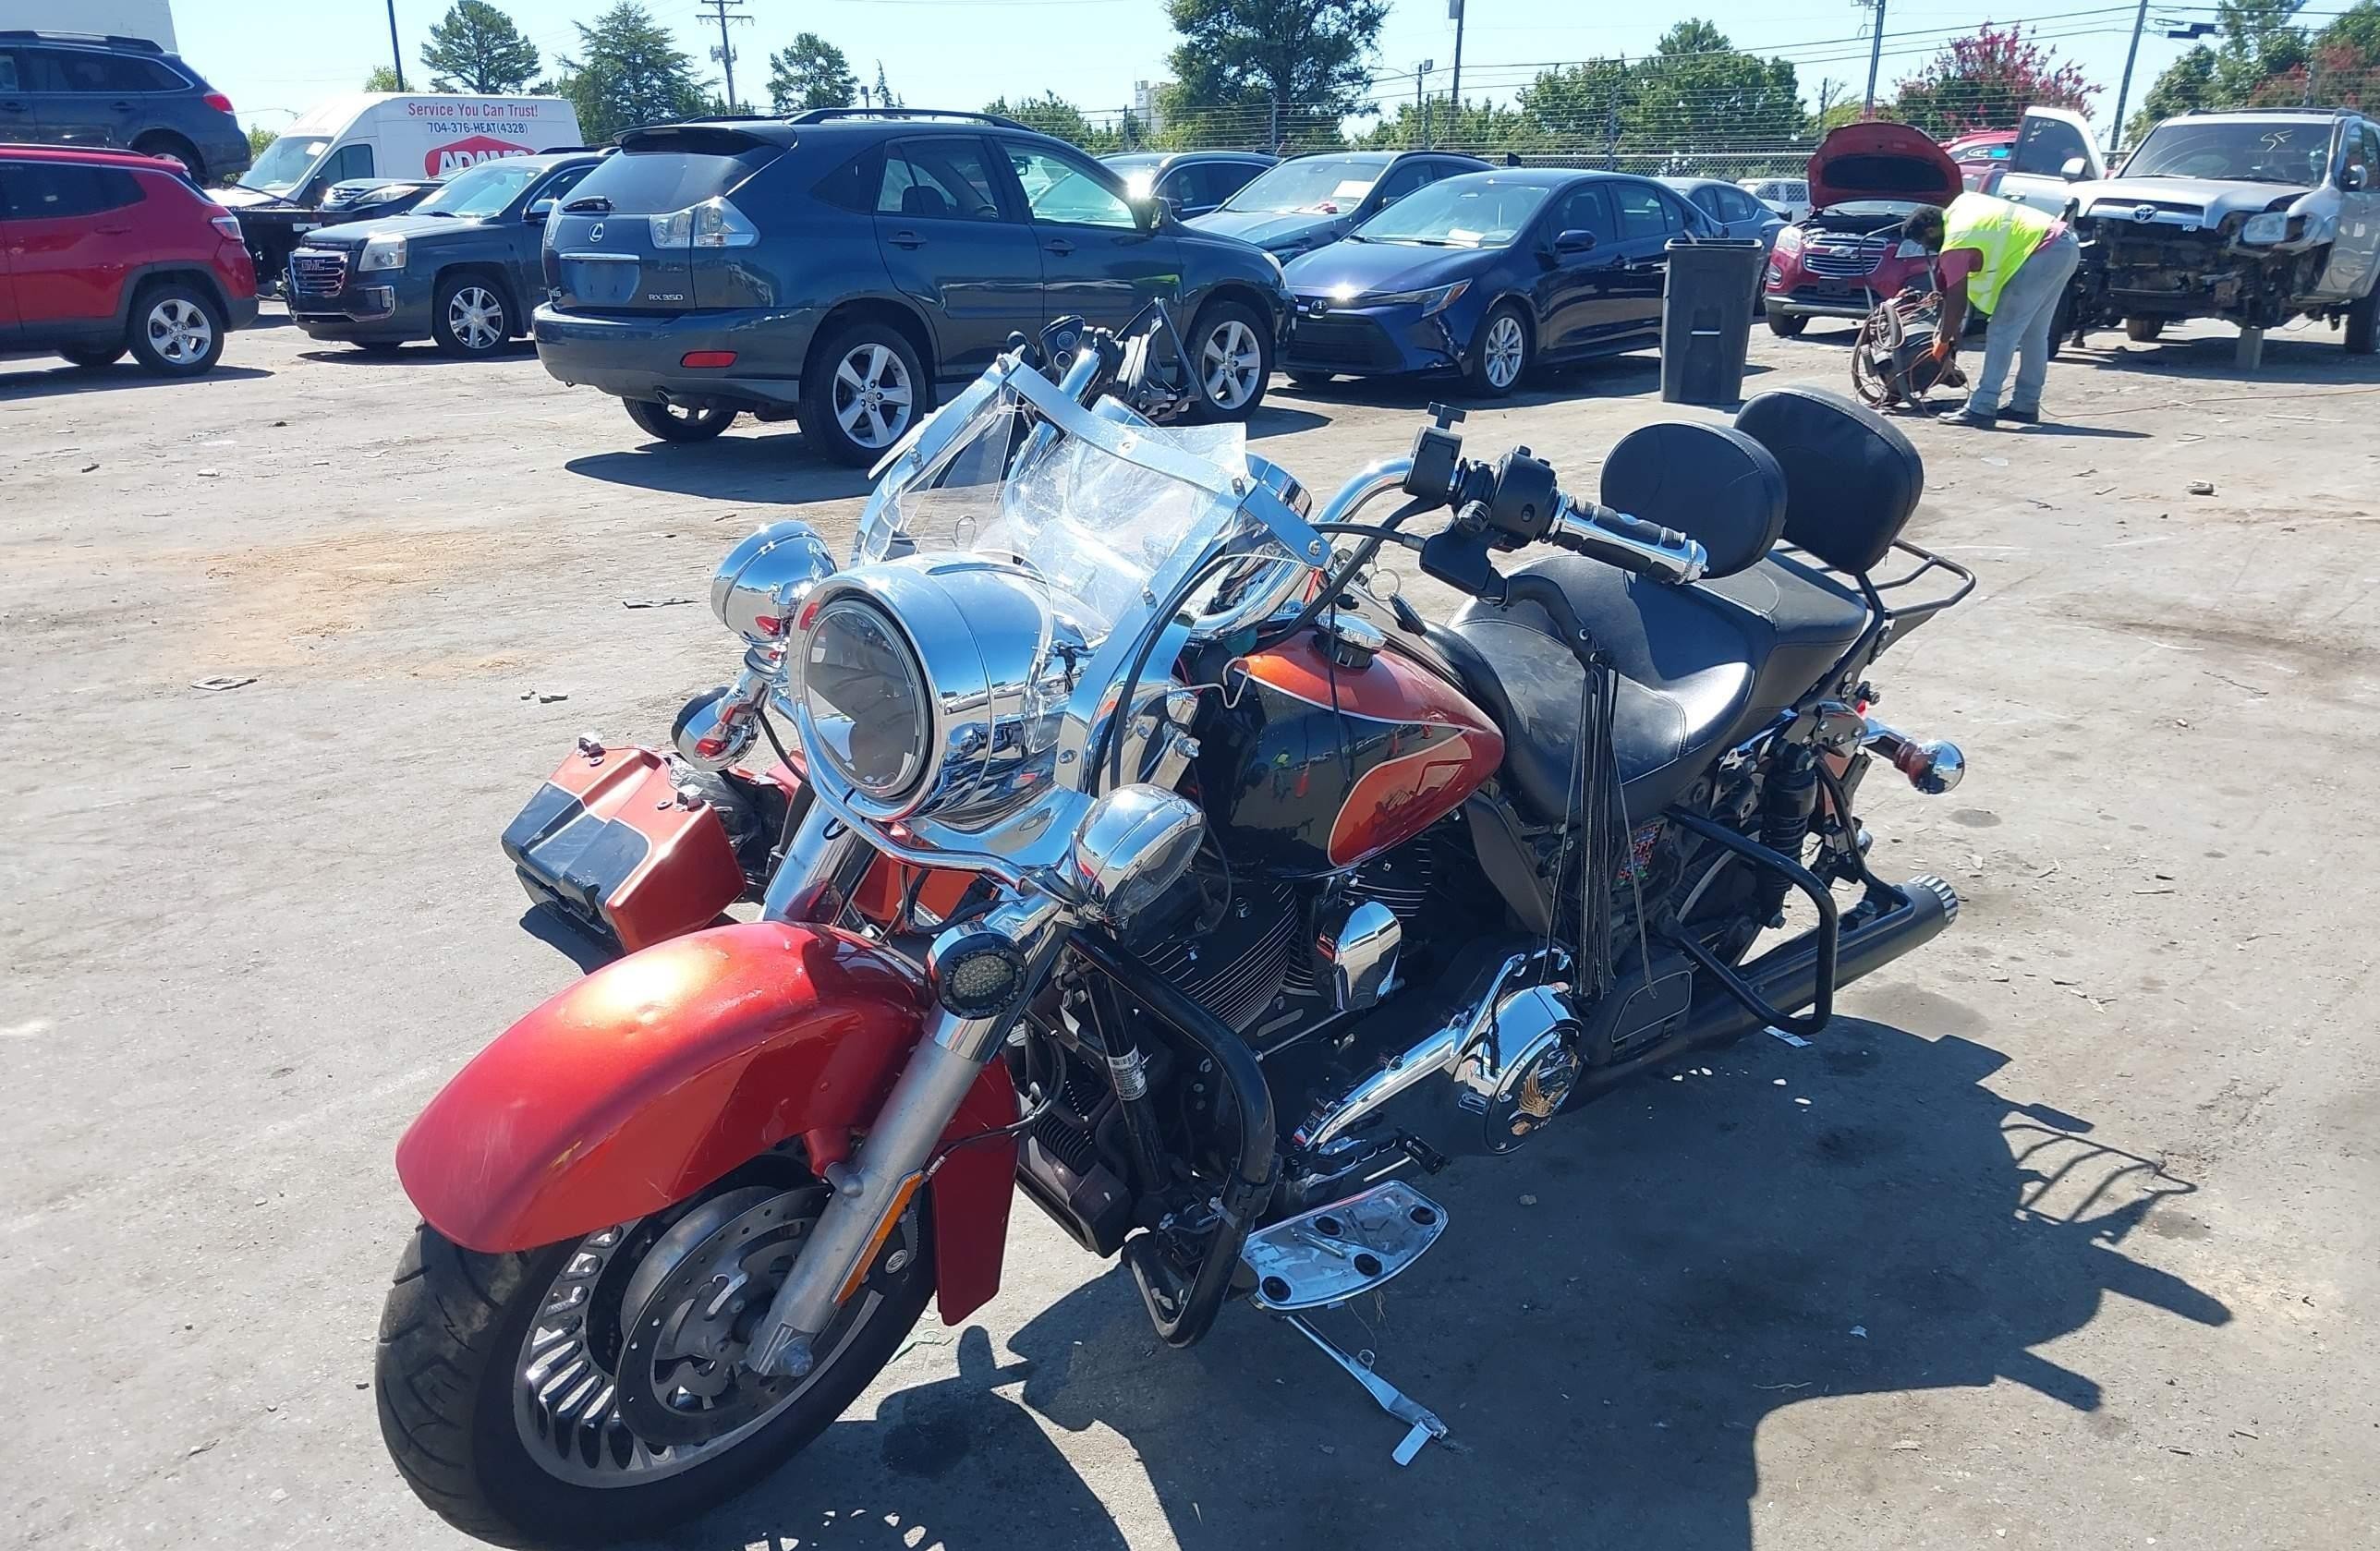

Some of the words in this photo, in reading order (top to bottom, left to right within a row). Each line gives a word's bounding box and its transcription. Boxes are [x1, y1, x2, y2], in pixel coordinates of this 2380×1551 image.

[408, 103, 453, 116] Service
[457, 103, 479, 116] You
[483, 103, 504, 116] Can
[507, 103, 538, 117] Trust!
[427, 122, 528, 134] 704-376-HEAT(4328)
[301, 259, 325, 271] GMC
